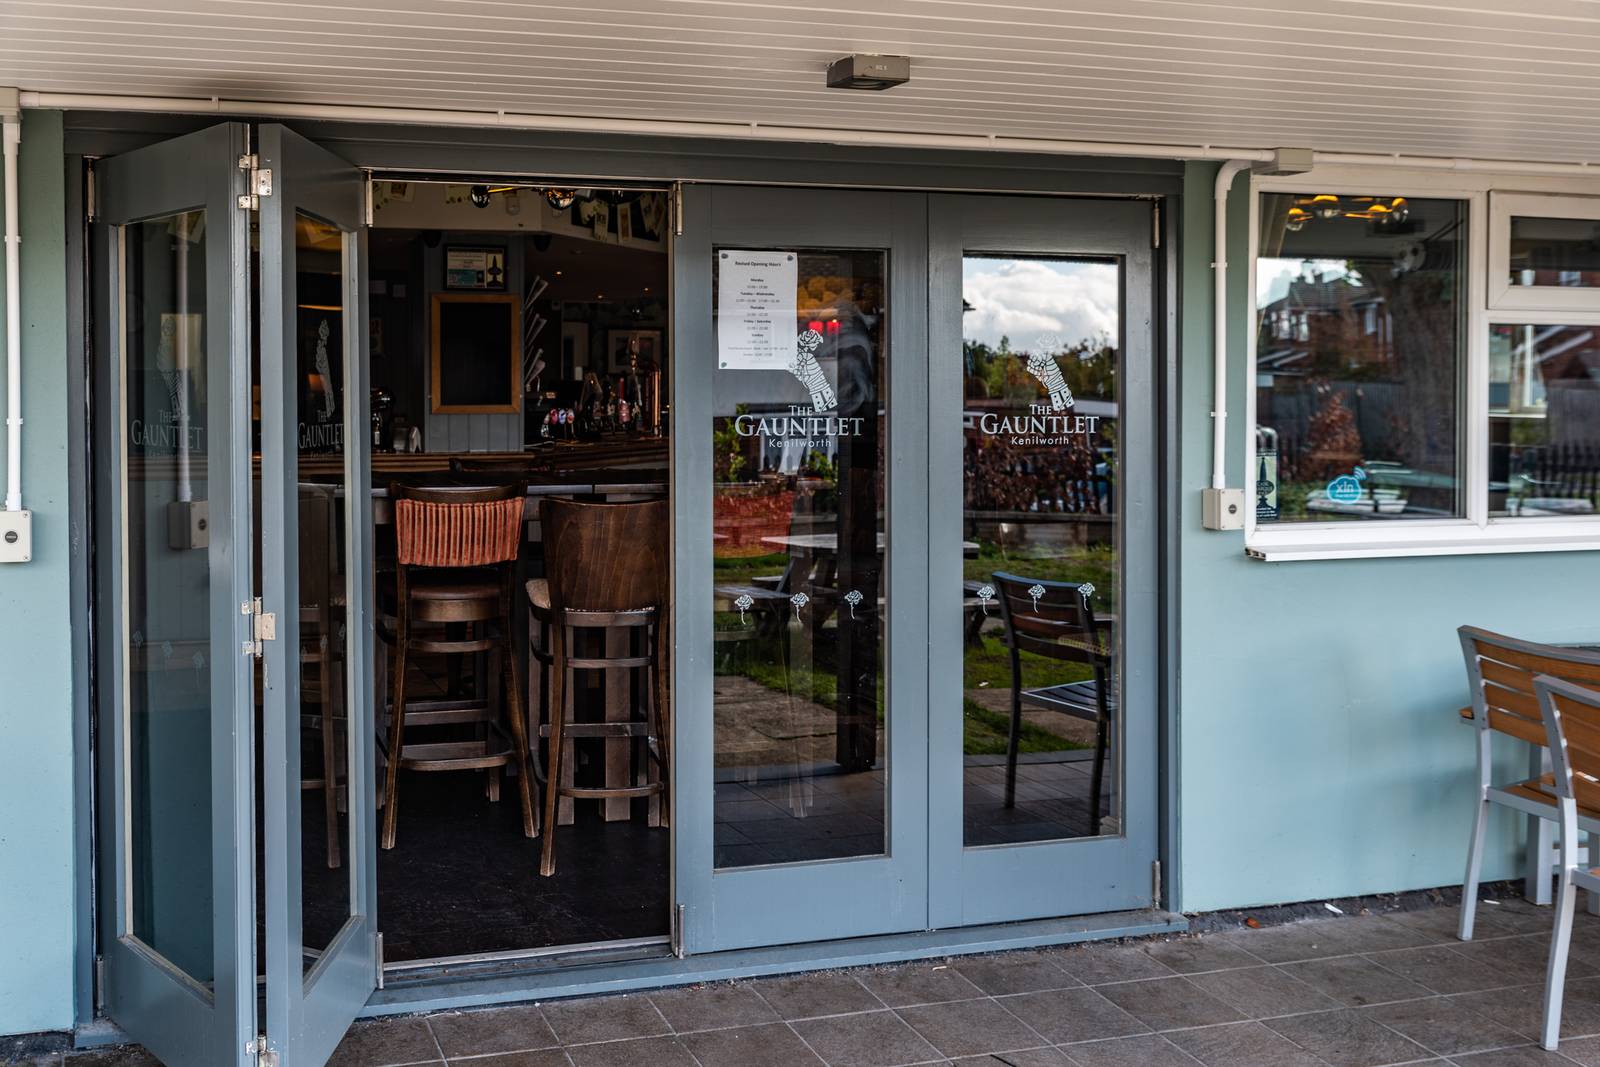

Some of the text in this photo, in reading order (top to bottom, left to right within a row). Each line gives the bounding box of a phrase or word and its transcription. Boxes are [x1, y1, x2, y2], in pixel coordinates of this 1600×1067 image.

[788, 405, 813, 416] THE
[1029, 404, 1052, 415] THE
[734, 414, 865, 437] GAUNTLET
[980, 413, 1100, 434] GAUNTLET
[298, 422, 344, 449] GAUNTLET
[1011, 436, 1069, 445] Kenilworth
[768, 438, 832, 448] Kenilworth
